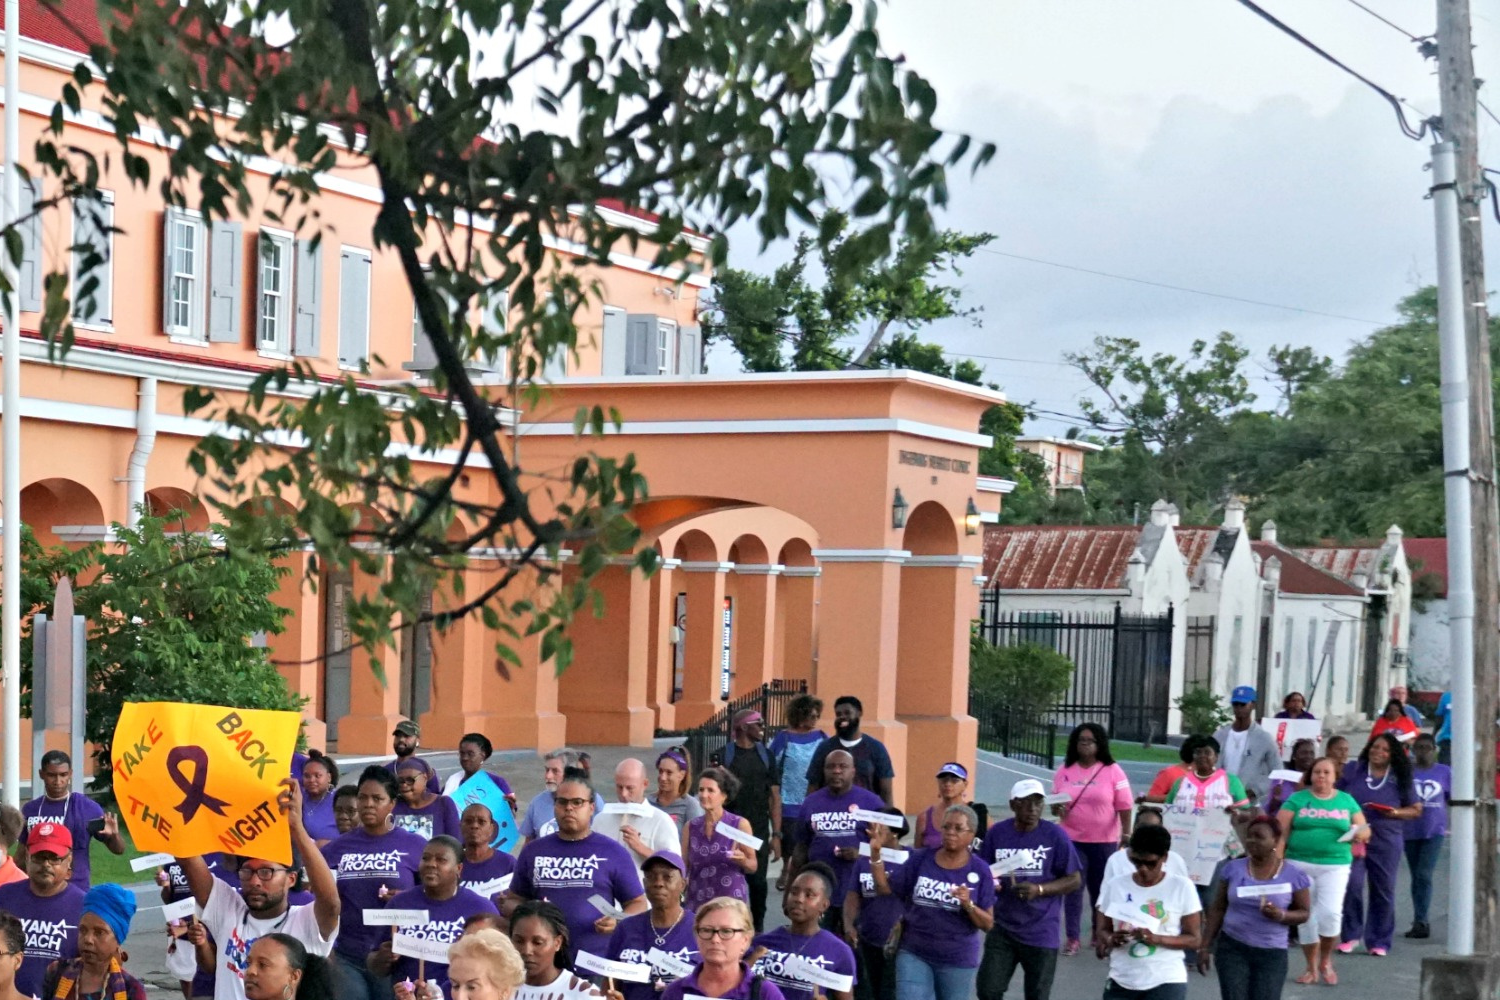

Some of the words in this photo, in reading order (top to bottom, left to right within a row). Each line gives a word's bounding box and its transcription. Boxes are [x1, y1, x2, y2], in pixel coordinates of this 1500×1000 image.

[113, 718, 163, 782] TAKE
[196, 712, 277, 780] BACK
[811, 812, 847, 822] BRYAN
[128, 795, 172, 841] THE
[218, 801, 277, 853] NIGHT
[817, 821, 856, 831] ROACH
[341, 852, 386, 863] BRYAN
[534, 856, 584, 868] BRYAN
[344, 860, 397, 871] ROACH
[541, 867, 594, 880] ROACH
[20, 918, 52, 934] YAN
[25, 933, 62, 951] ACH
